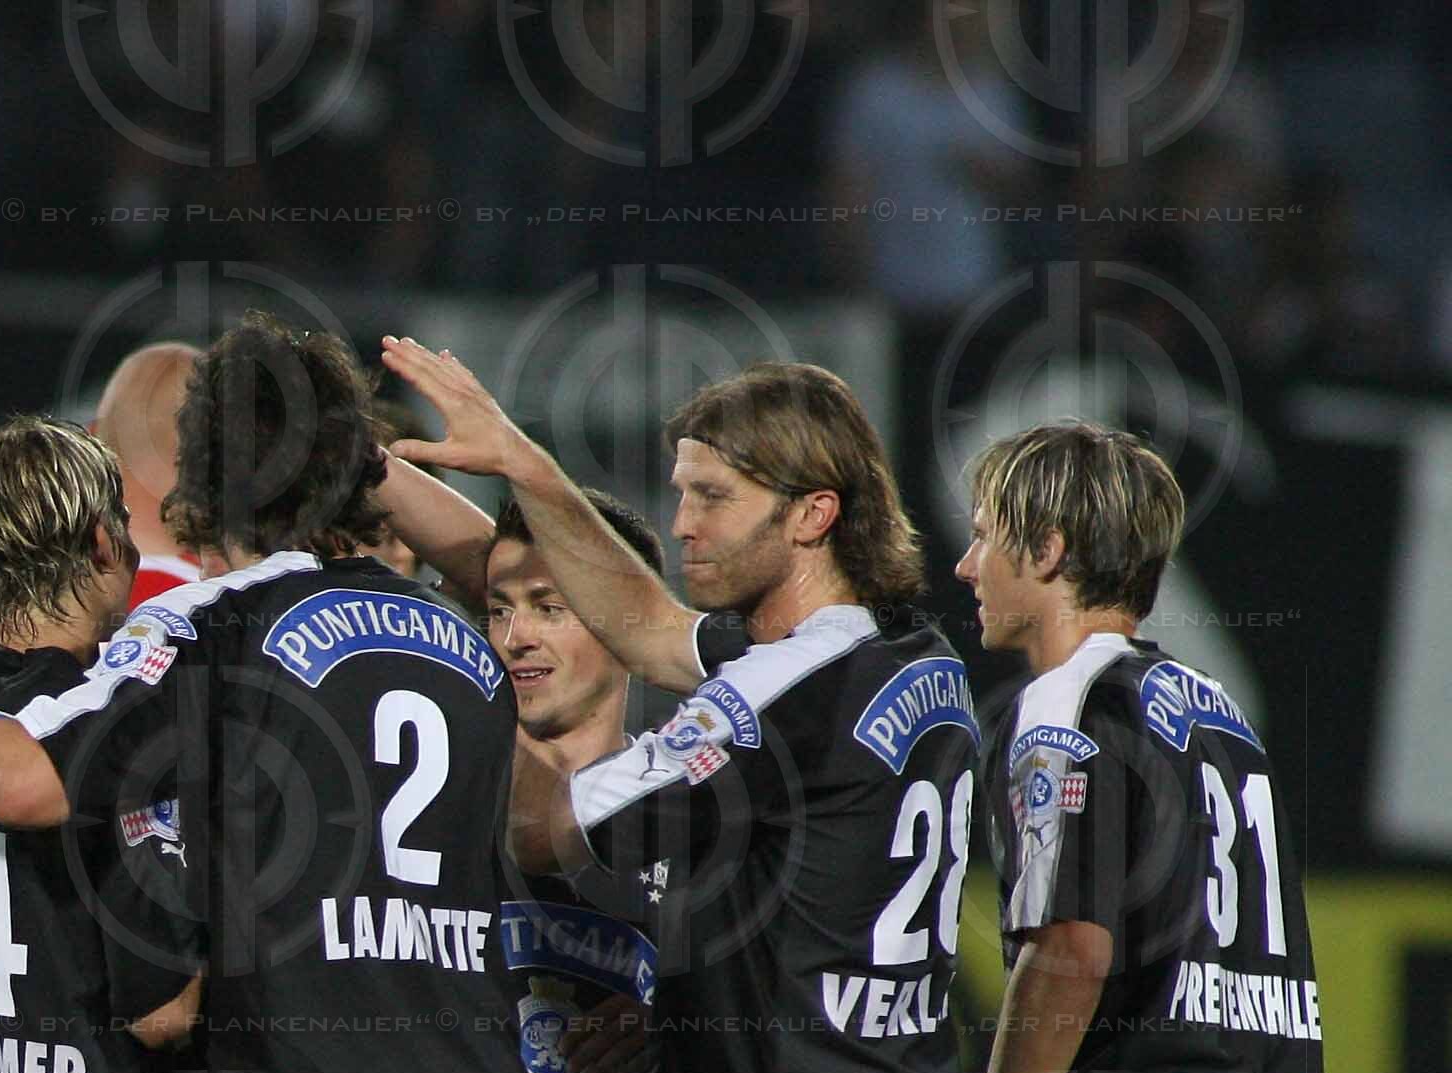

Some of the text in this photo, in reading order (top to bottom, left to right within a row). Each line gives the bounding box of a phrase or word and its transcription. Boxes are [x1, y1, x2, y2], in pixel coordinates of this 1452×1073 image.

[276, 600, 497, 688] PUNTIGAMER
[867, 671, 975, 757] PUNTIGAM
[374, 689, 449, 886] 2
[1201, 761, 1287, 957] 31
[822, 972, 956, 1038] VERL
